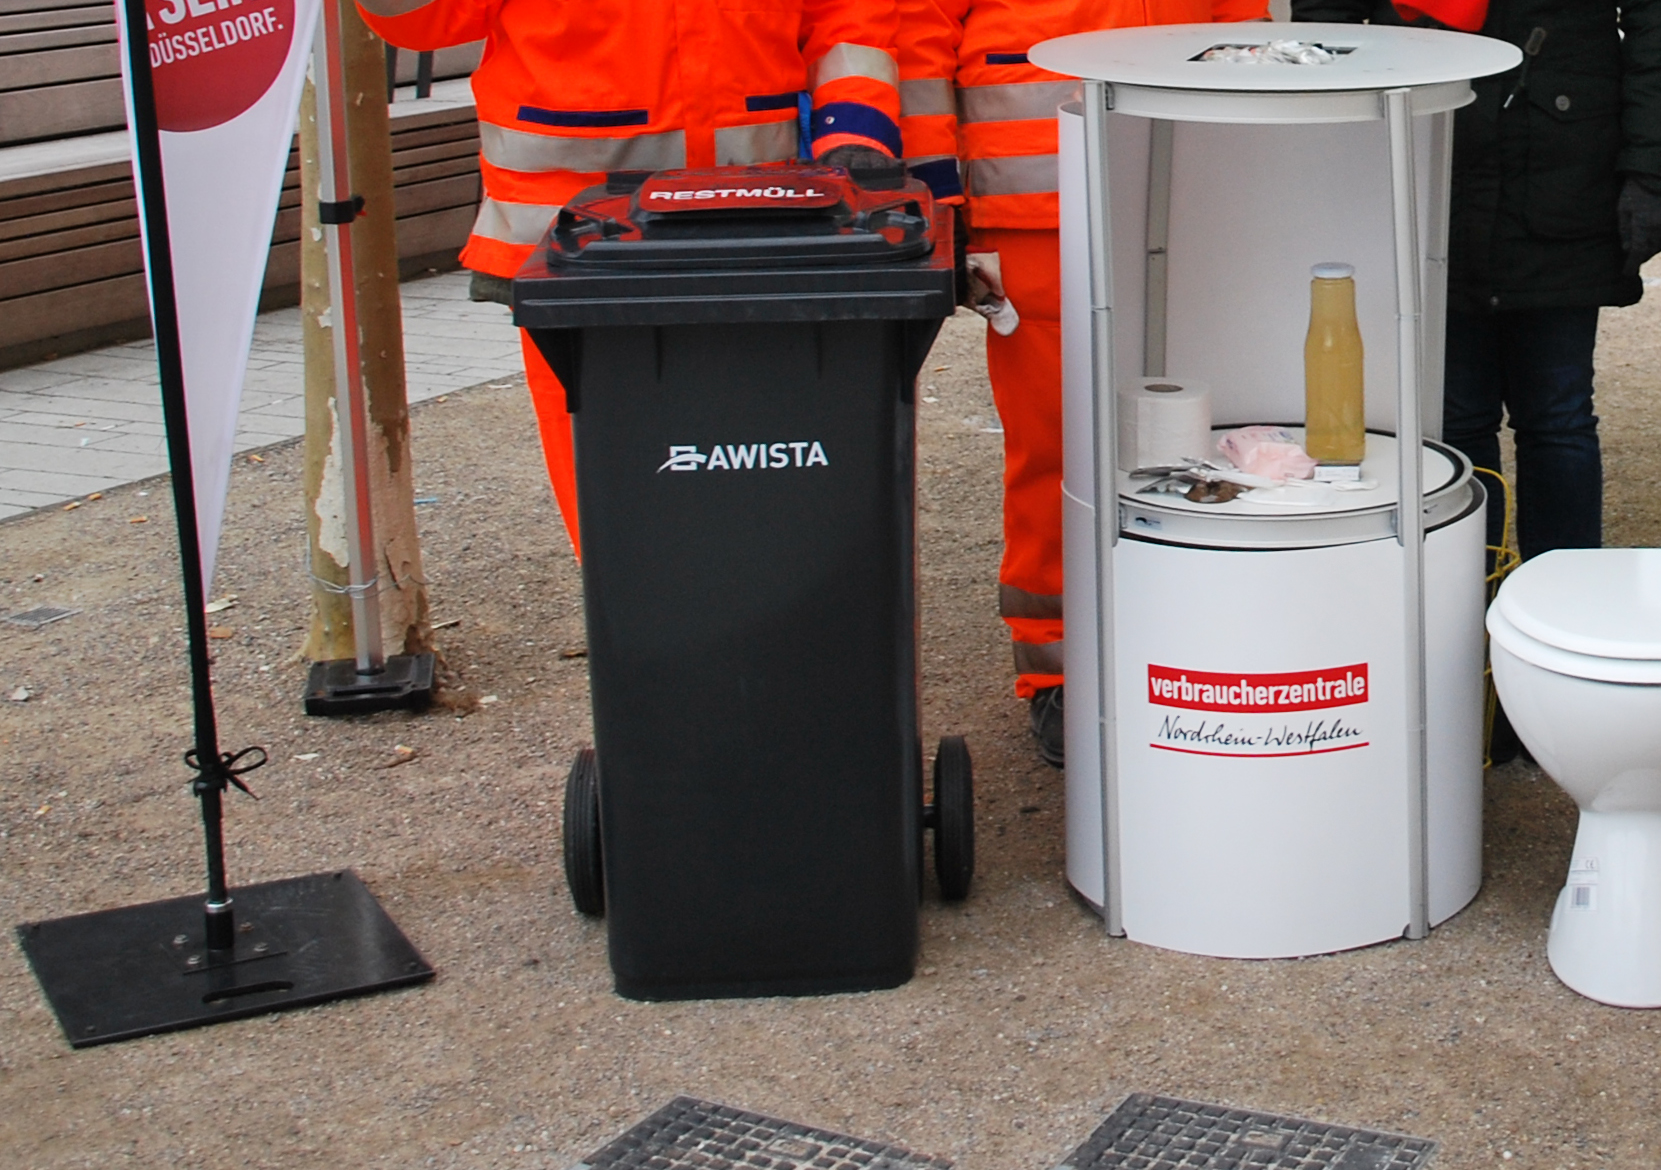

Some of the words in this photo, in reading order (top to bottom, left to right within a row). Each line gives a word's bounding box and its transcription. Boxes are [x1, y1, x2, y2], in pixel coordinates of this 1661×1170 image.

[149, 7, 284, 69] DÜSSELDORF.
[650, 186, 825, 200] RESTMÜLL
[706, 441, 829, 470] AWISTA
[1150, 671, 1365, 706] verbraucherzentrale
[1157, 714, 1363, 751] Nordrhein-Westfalen
